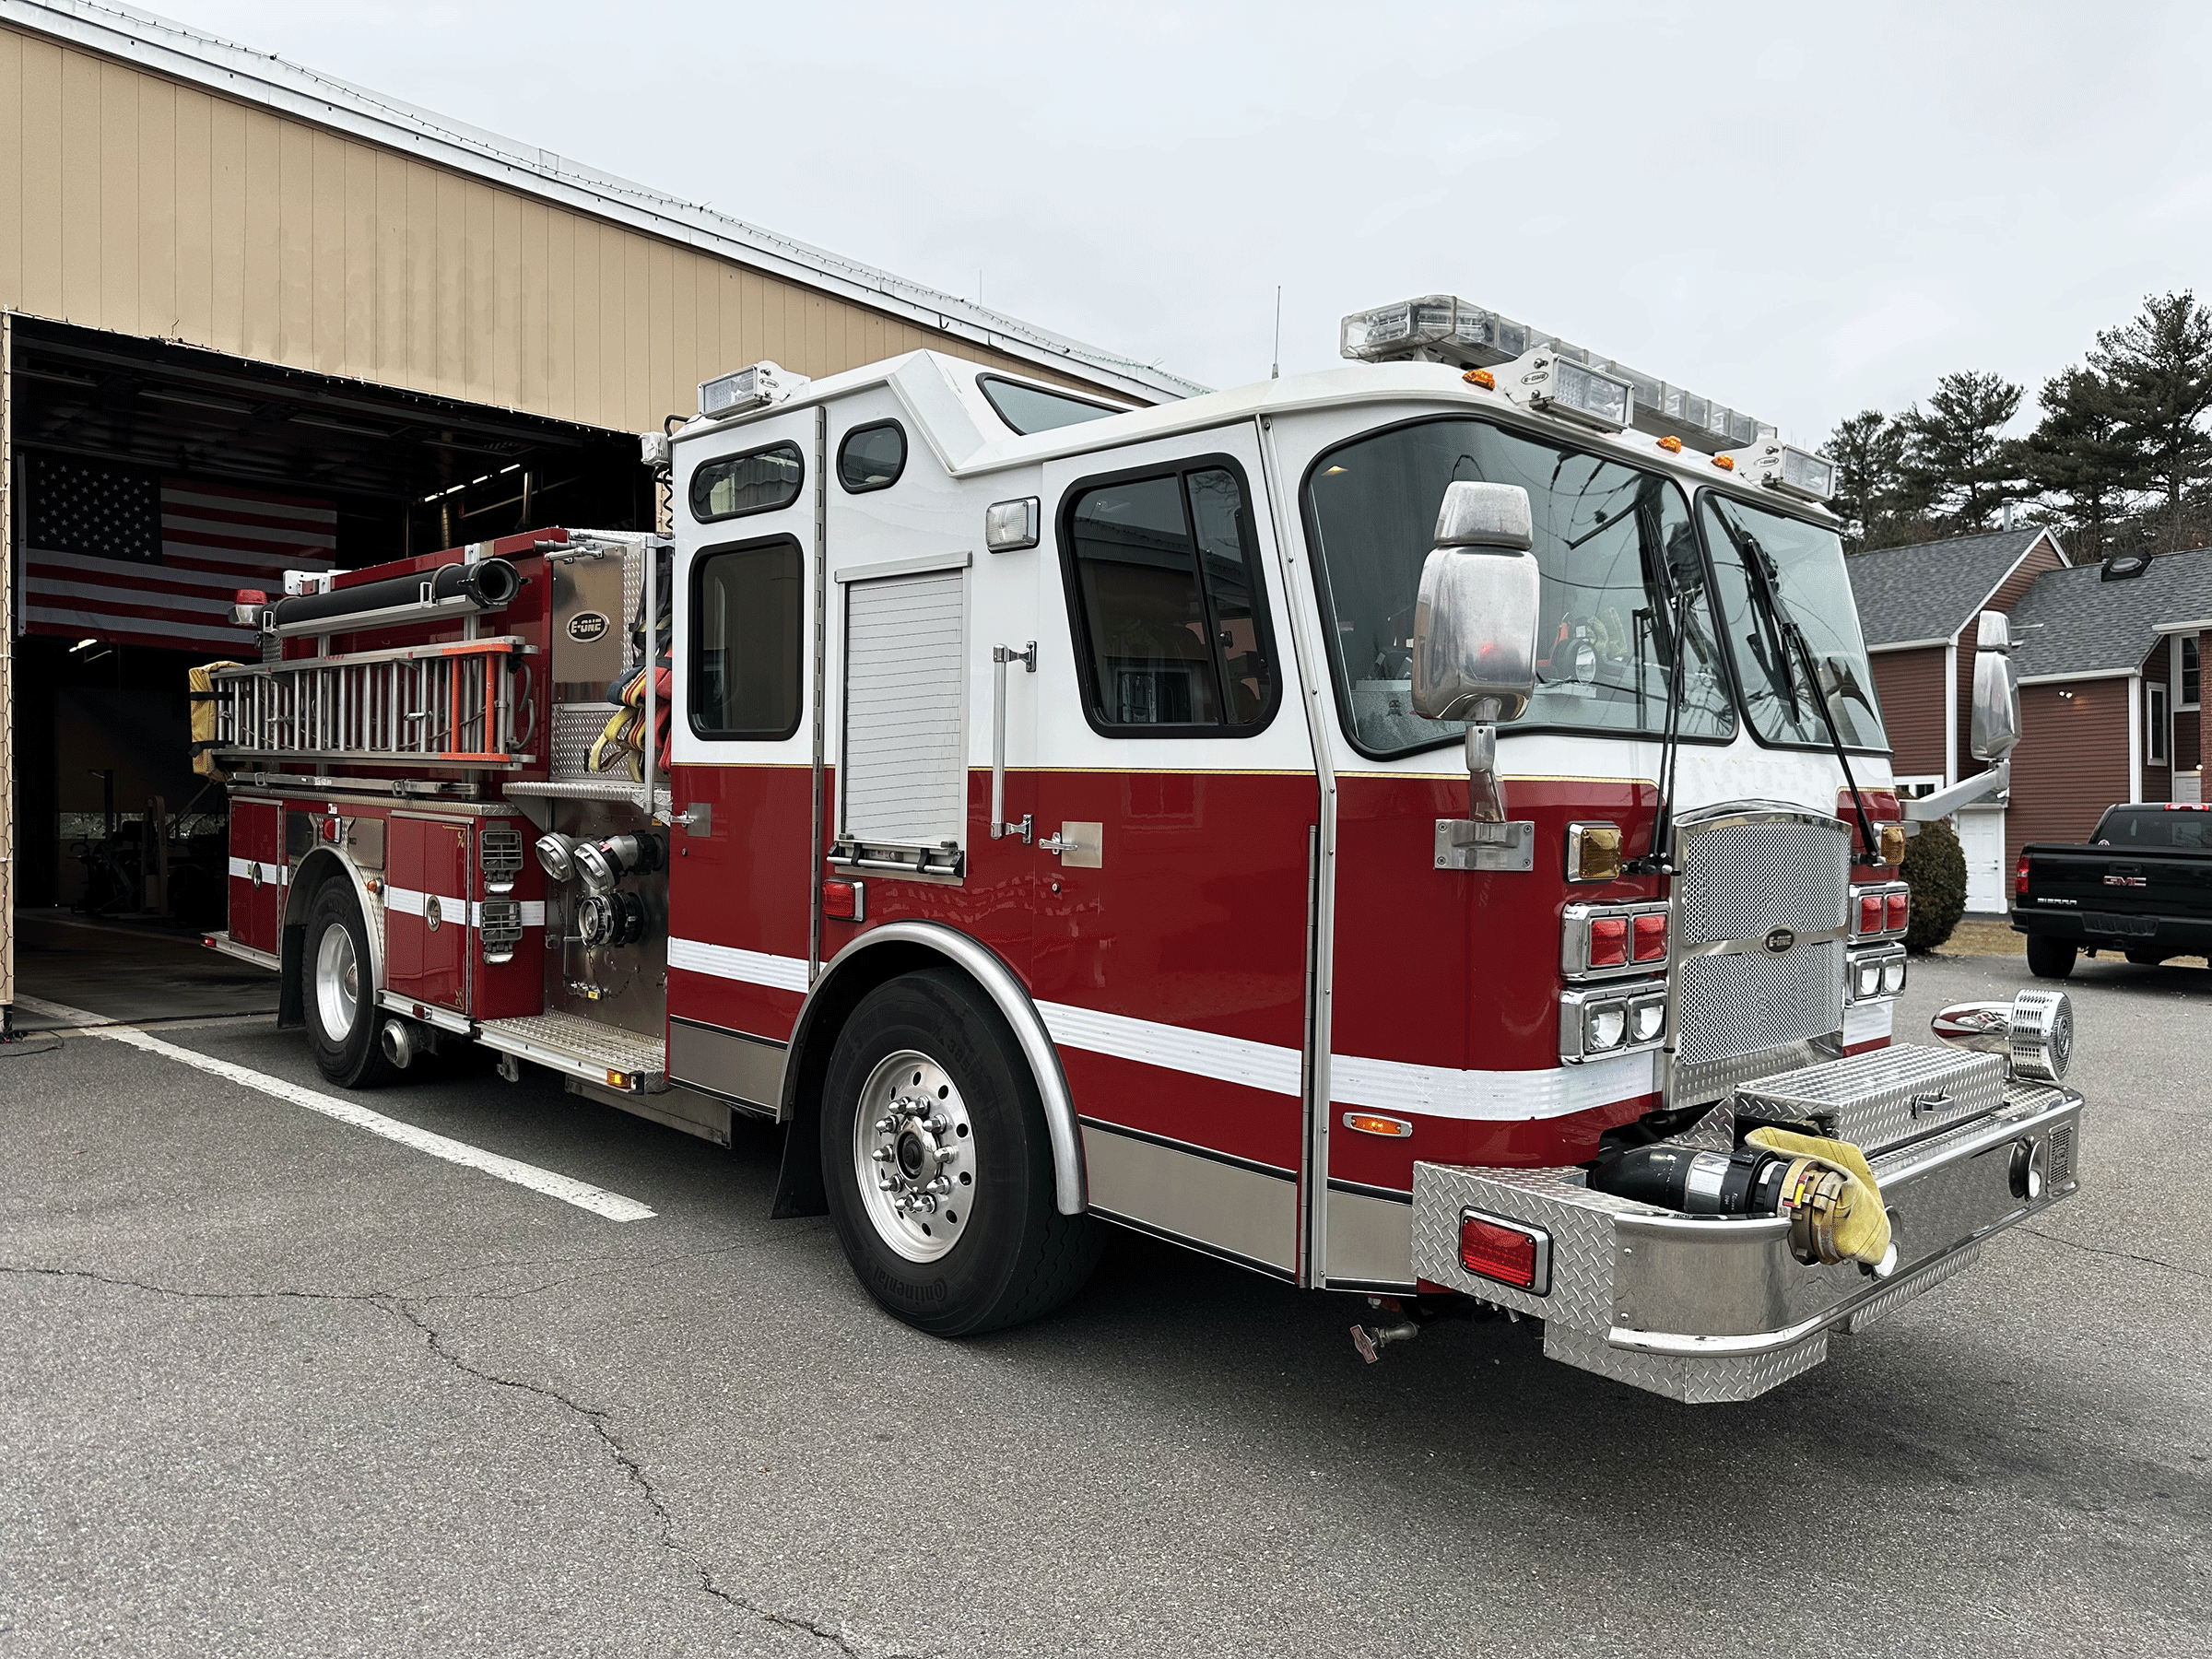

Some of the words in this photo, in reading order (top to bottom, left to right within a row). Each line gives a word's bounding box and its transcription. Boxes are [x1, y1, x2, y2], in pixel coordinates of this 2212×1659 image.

[571, 618, 602, 634] E-ONE
[2103, 876, 2147, 887] GMC
[2037, 898, 2077, 906] SIERRA
[1769, 934, 1792, 947] E-ONE
[872, 1264, 948, 1306] Continental
